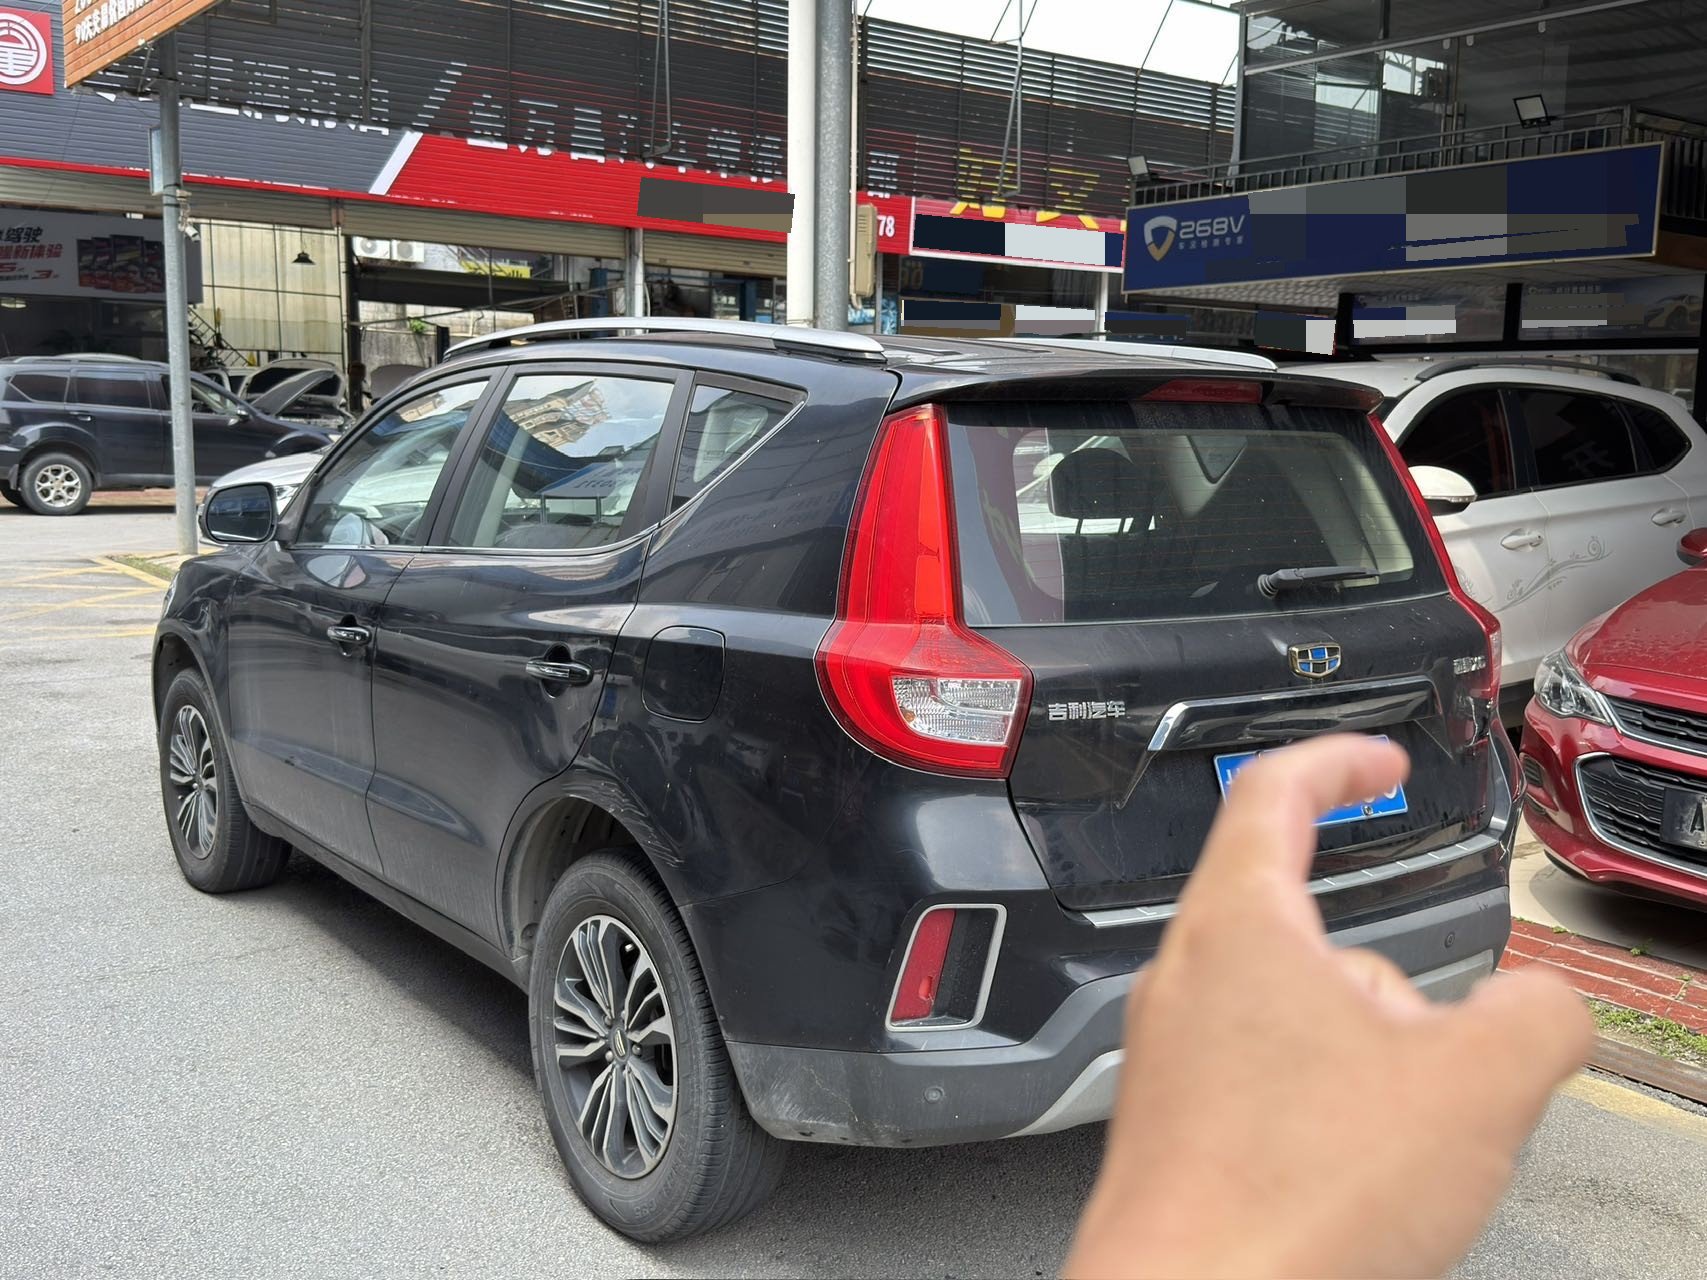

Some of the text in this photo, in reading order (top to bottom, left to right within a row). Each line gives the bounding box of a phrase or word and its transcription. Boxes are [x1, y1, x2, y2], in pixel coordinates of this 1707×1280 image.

[0, 226, 43, 243] 驾驶
[1179, 214, 1245, 239] 268V
[1048, 701, 1125, 721] 吉利汽车
